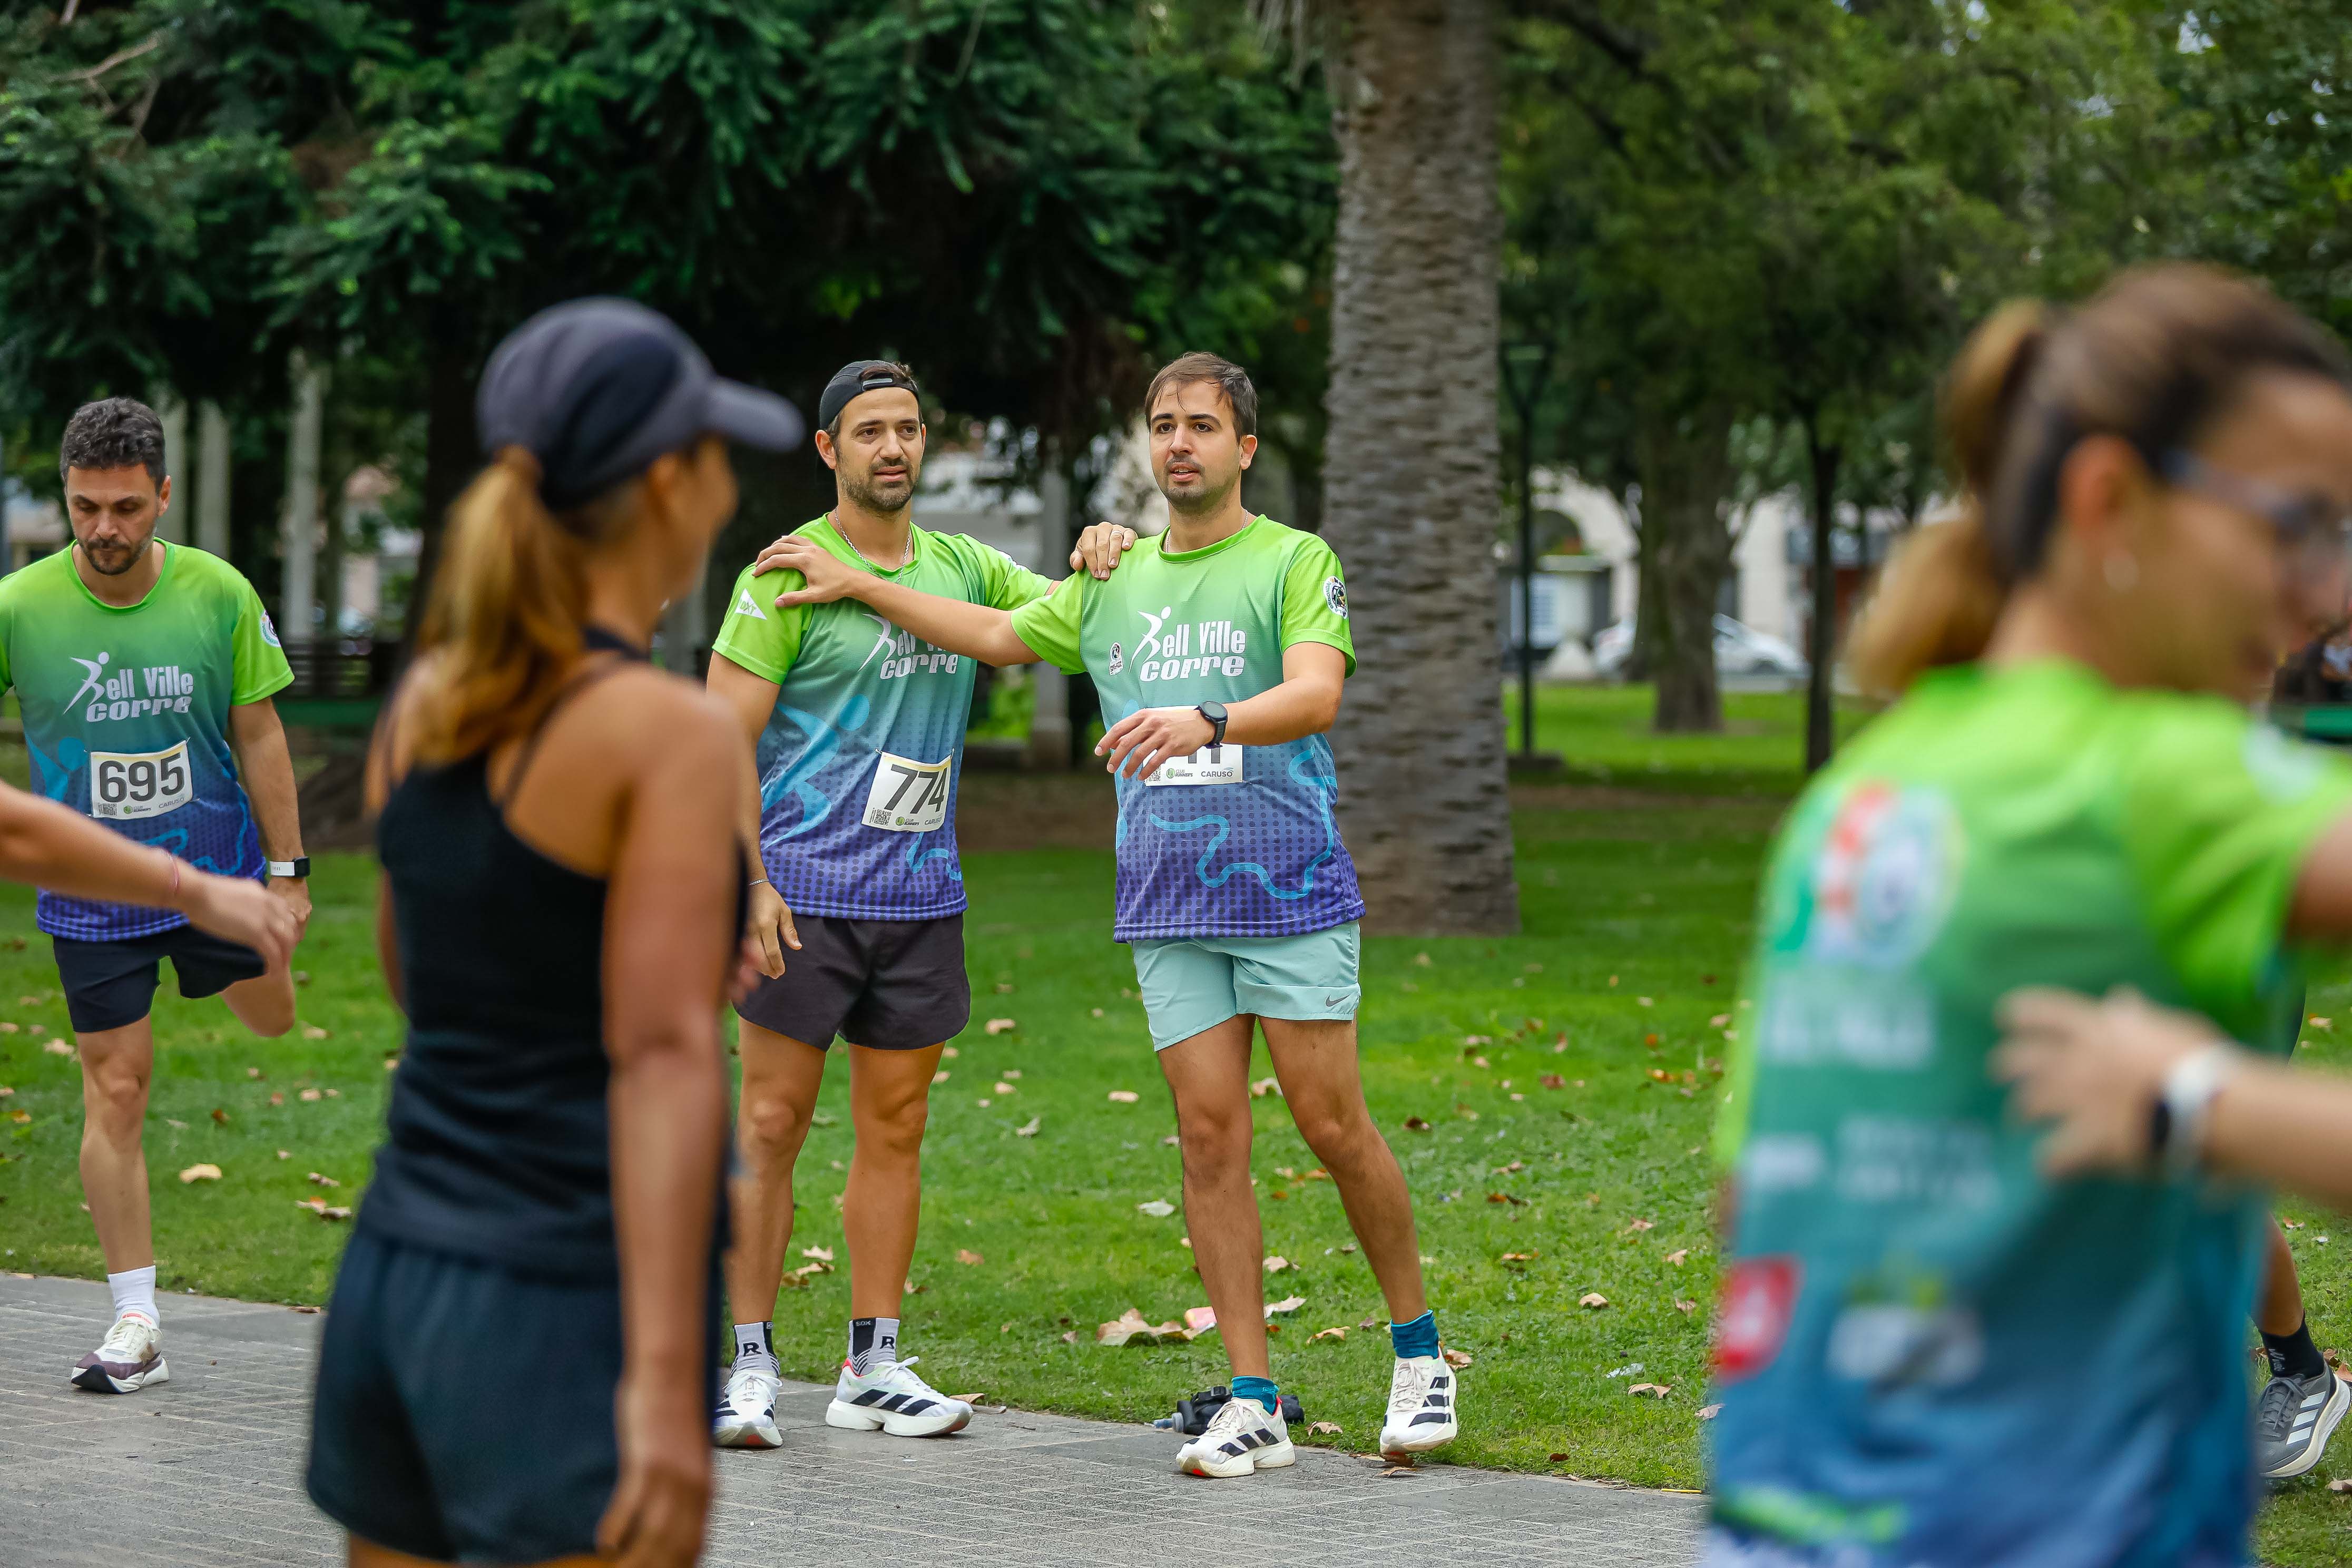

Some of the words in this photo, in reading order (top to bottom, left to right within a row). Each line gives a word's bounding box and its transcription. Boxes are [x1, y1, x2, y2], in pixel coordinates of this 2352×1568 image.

[1199, 620, 1246, 654] Ville
[880, 654, 958, 680] corre
[1140, 655, 1245, 682] corre
[143, 665, 194, 697] Ville
[86, 696, 193, 722] corre
[99, 752, 185, 803] 695
[884, 764, 948, 814] 774
[743, 1342, 762, 1357] R
[880, 1336, 895, 1349] R
